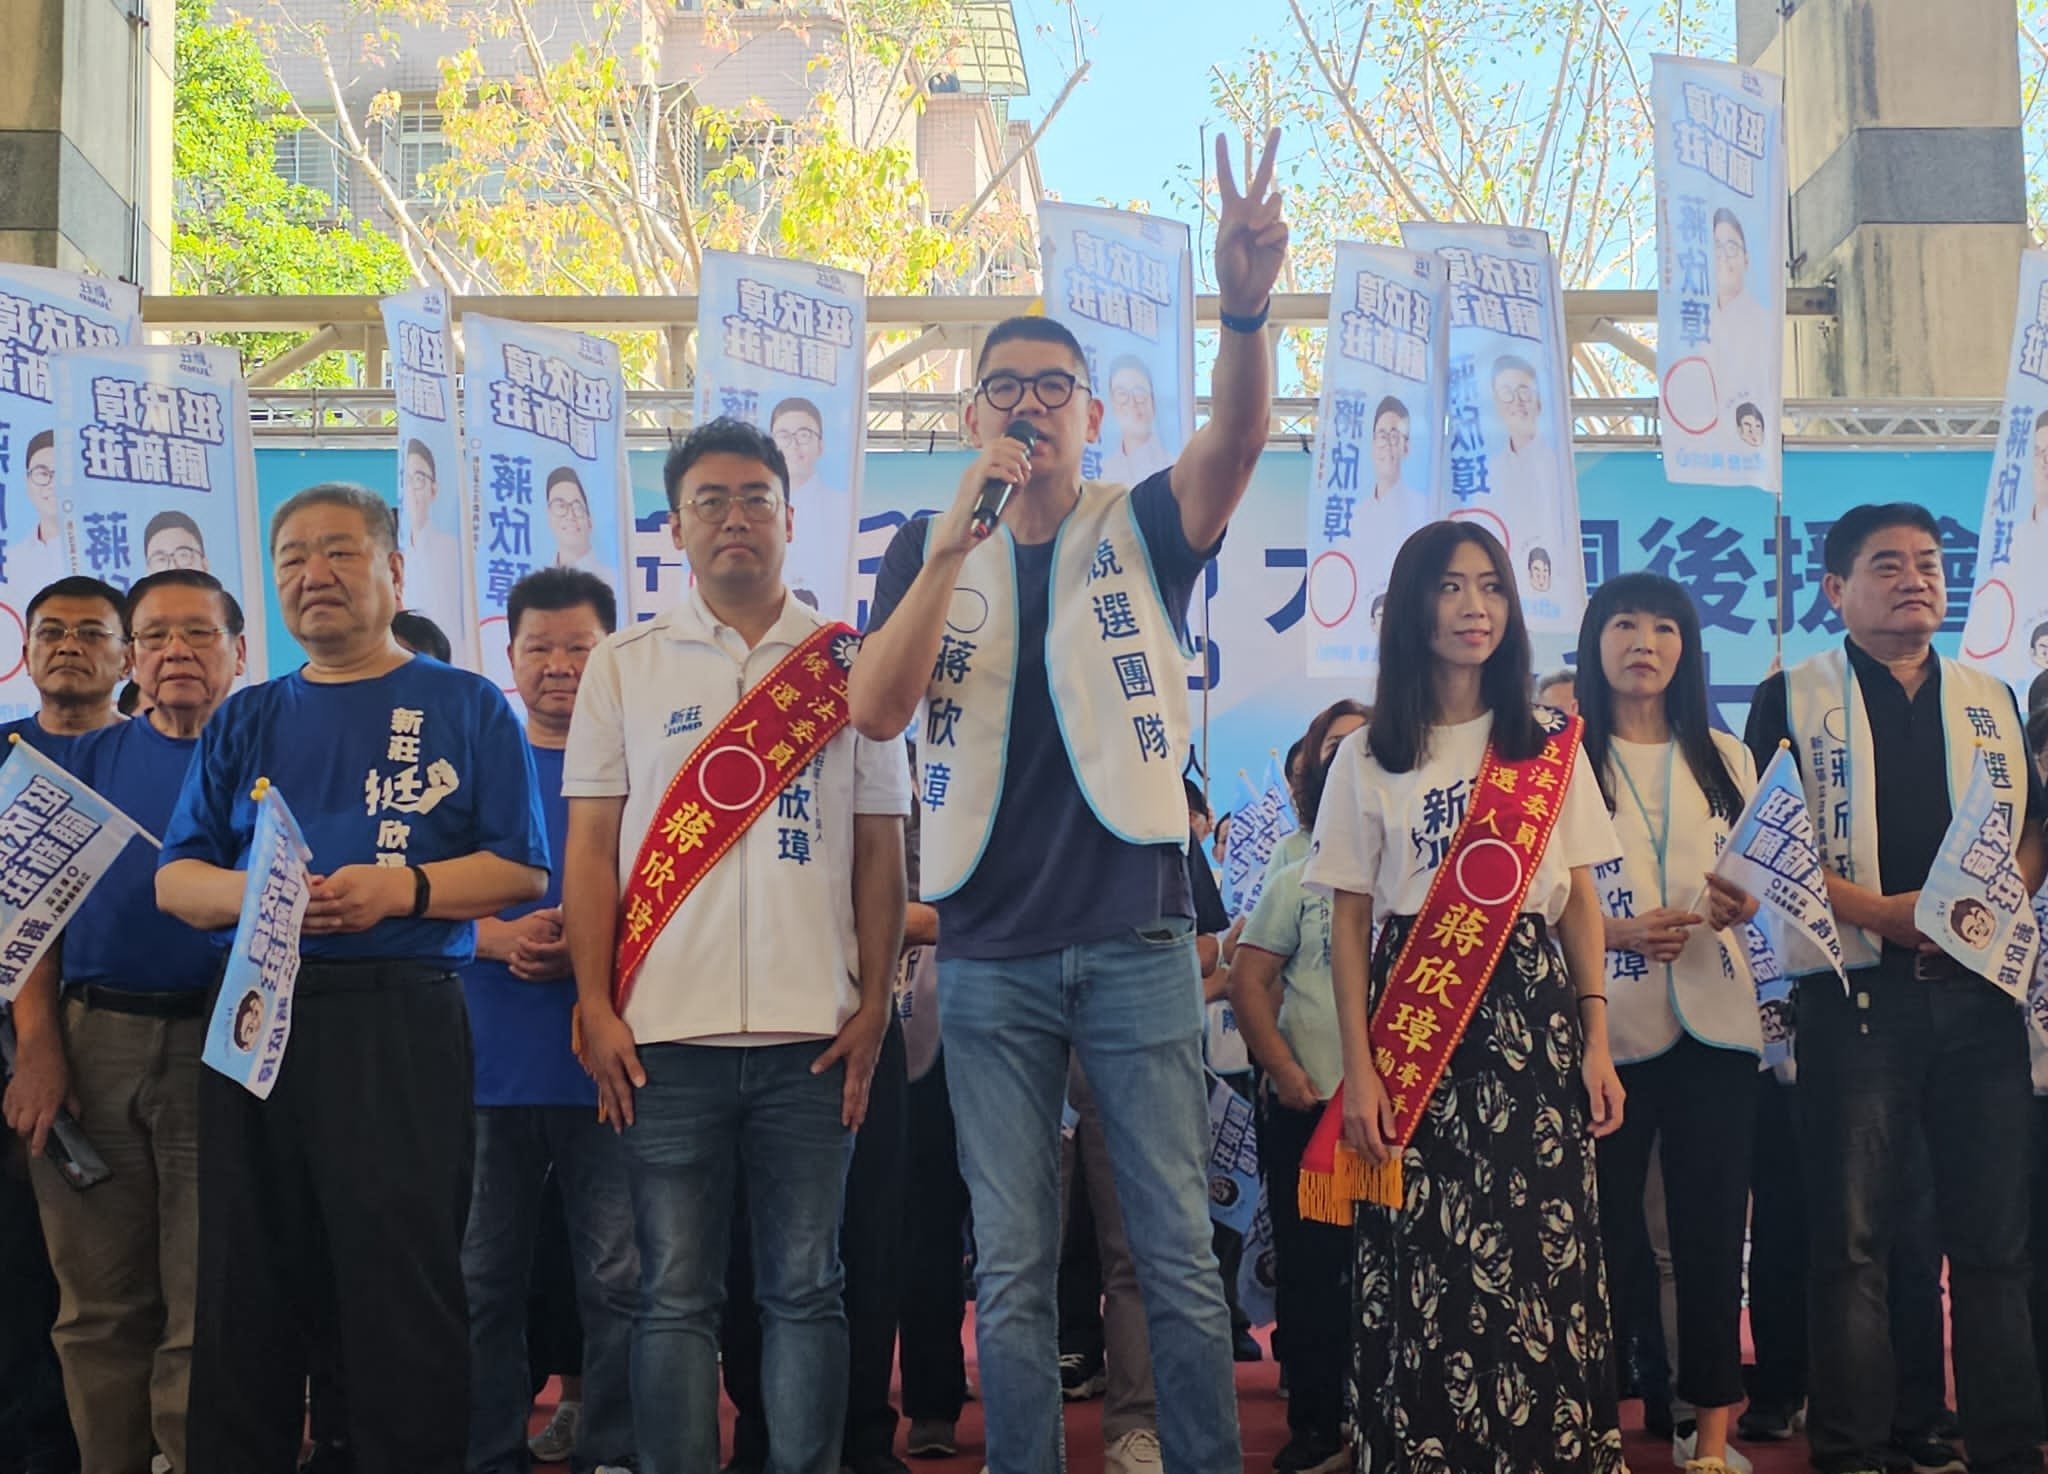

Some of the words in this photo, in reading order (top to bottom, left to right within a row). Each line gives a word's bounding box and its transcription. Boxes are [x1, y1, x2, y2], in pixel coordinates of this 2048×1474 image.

[664, 718, 703, 738] JUMP
[777, 762, 812, 866] 欣璋
[1424, 775, 1479, 835] 新
[1511, 739, 1564, 855] 立法委員
[626, 800, 716, 944] 蔣欣璋
[1387, 902, 1491, 1056] 蔣欣璋
